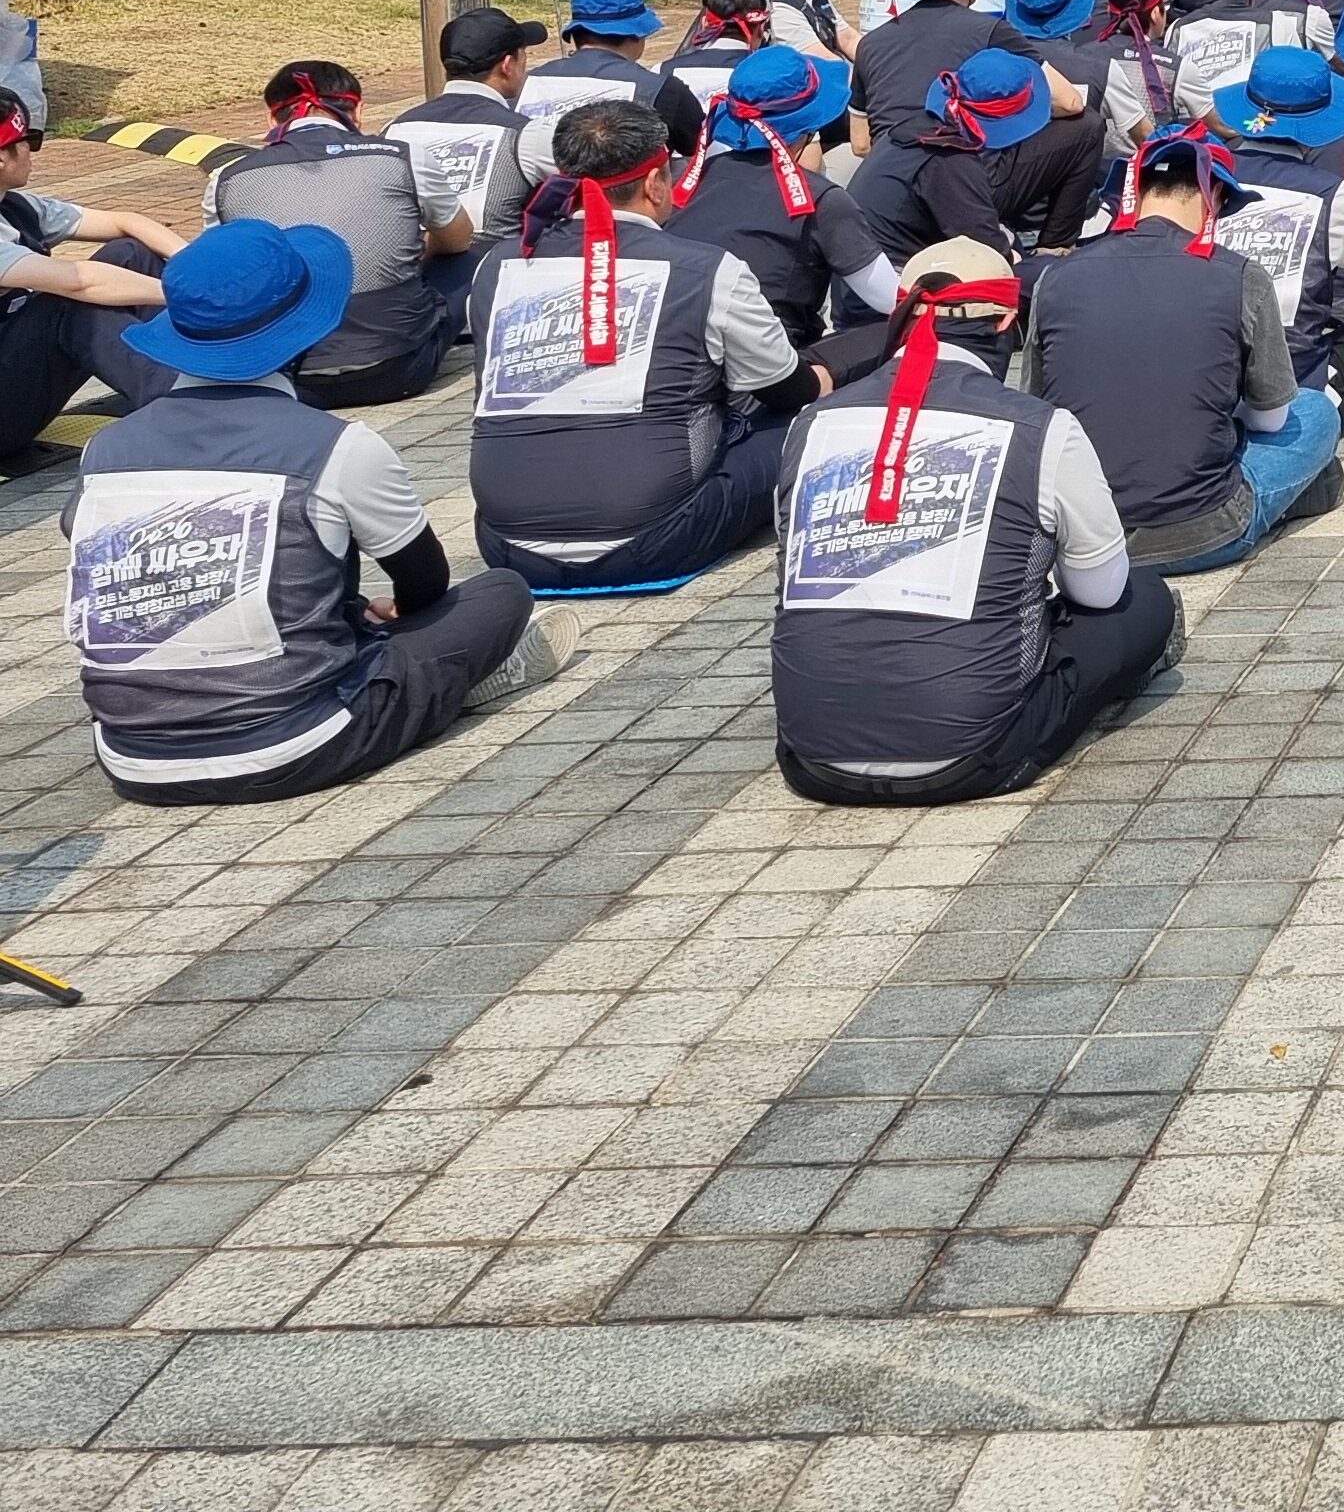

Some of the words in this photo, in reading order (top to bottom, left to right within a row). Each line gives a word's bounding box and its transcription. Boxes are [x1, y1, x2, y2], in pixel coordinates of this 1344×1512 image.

[541, 295, 583, 320] 202
[589, 241, 609, 346] 전국금속노동조합
[503, 318, 551, 349] 함께
[811, 484, 871, 523] 함께
[128, 513, 194, 557] 2026
[810, 527, 833, 544] 모든
[919, 508, 955, 524] 보장!
[90, 553, 143, 589] 함께
[146, 532, 245, 575] 싸우자
[94, 594, 118, 609] 모든
[118, 584, 167, 604] 노동자의
[169, 576, 194, 592] 고용
[195, 569, 231, 587] 보장!
